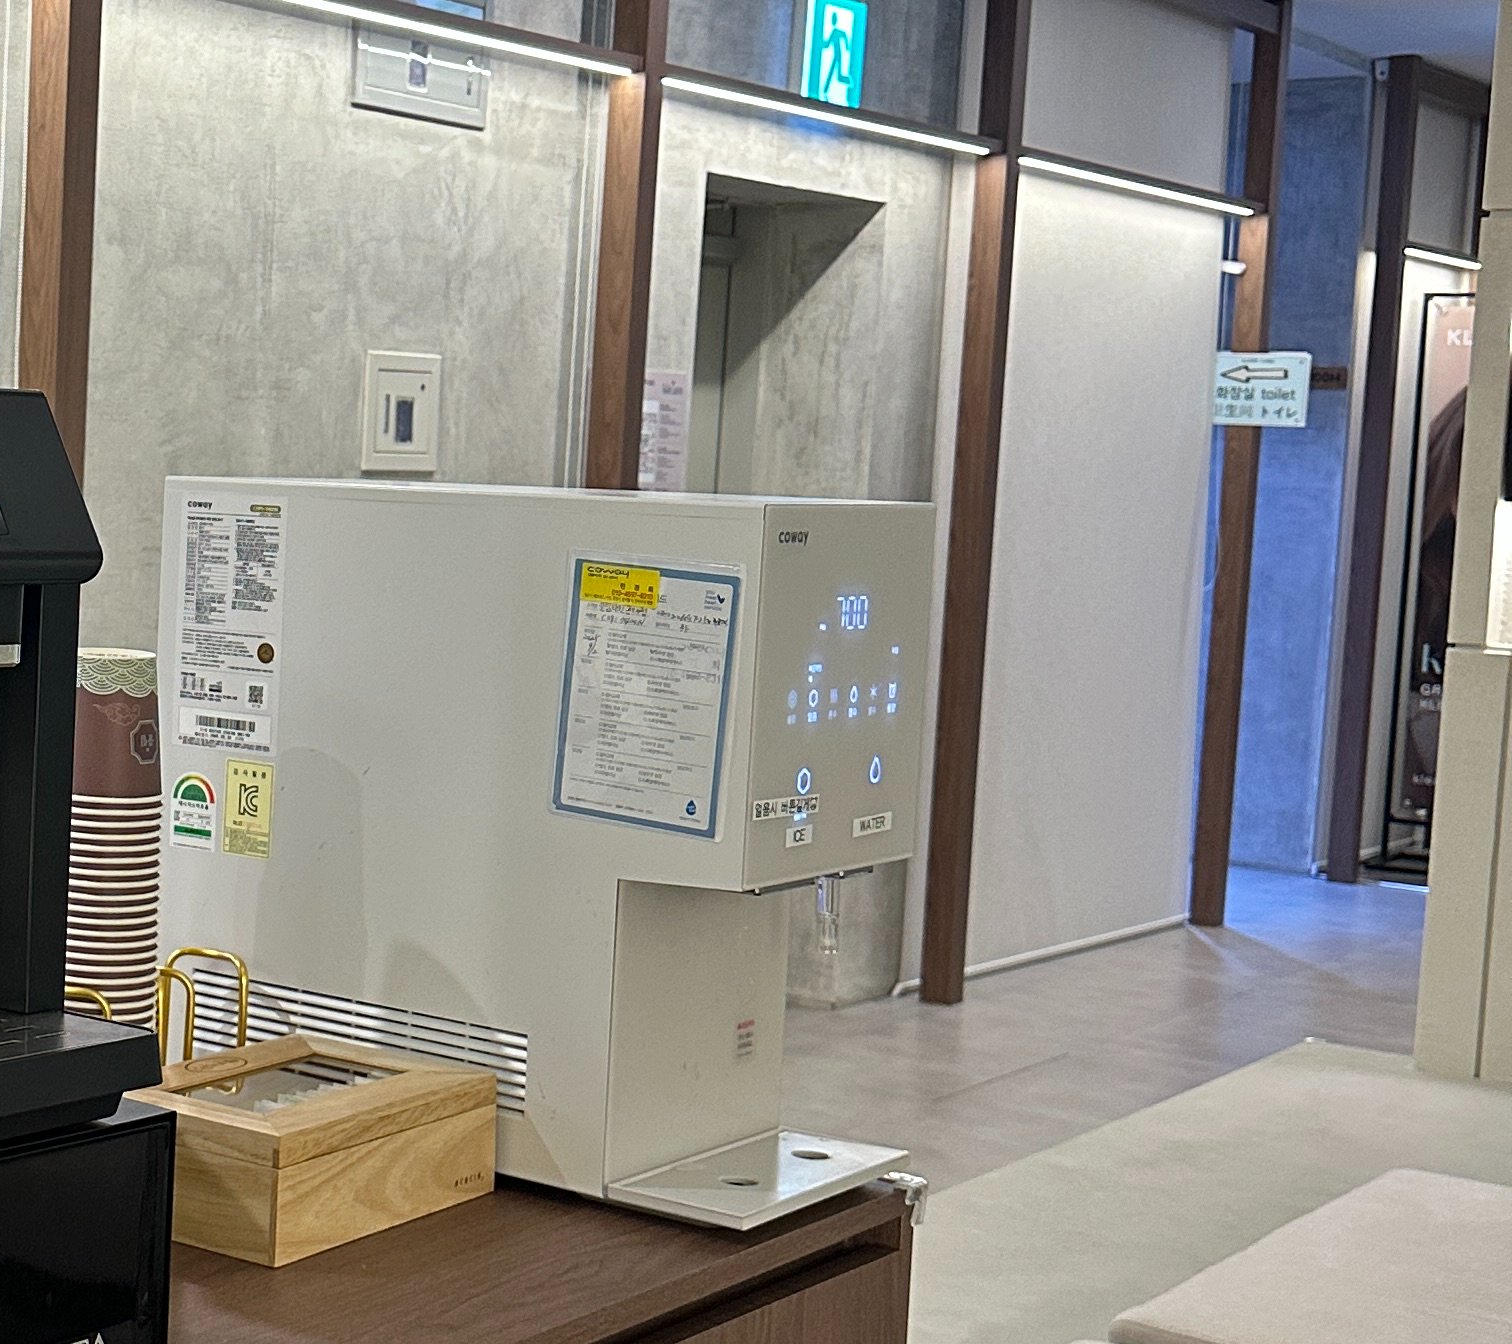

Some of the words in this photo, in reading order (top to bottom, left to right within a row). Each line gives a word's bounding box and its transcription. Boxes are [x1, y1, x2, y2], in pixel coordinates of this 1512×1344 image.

[1216, 385, 1254, 400] 화장실
[1261, 387, 1297, 401] toilet
[778, 530, 810, 546] coway
[859, 816, 886, 833] WATER
